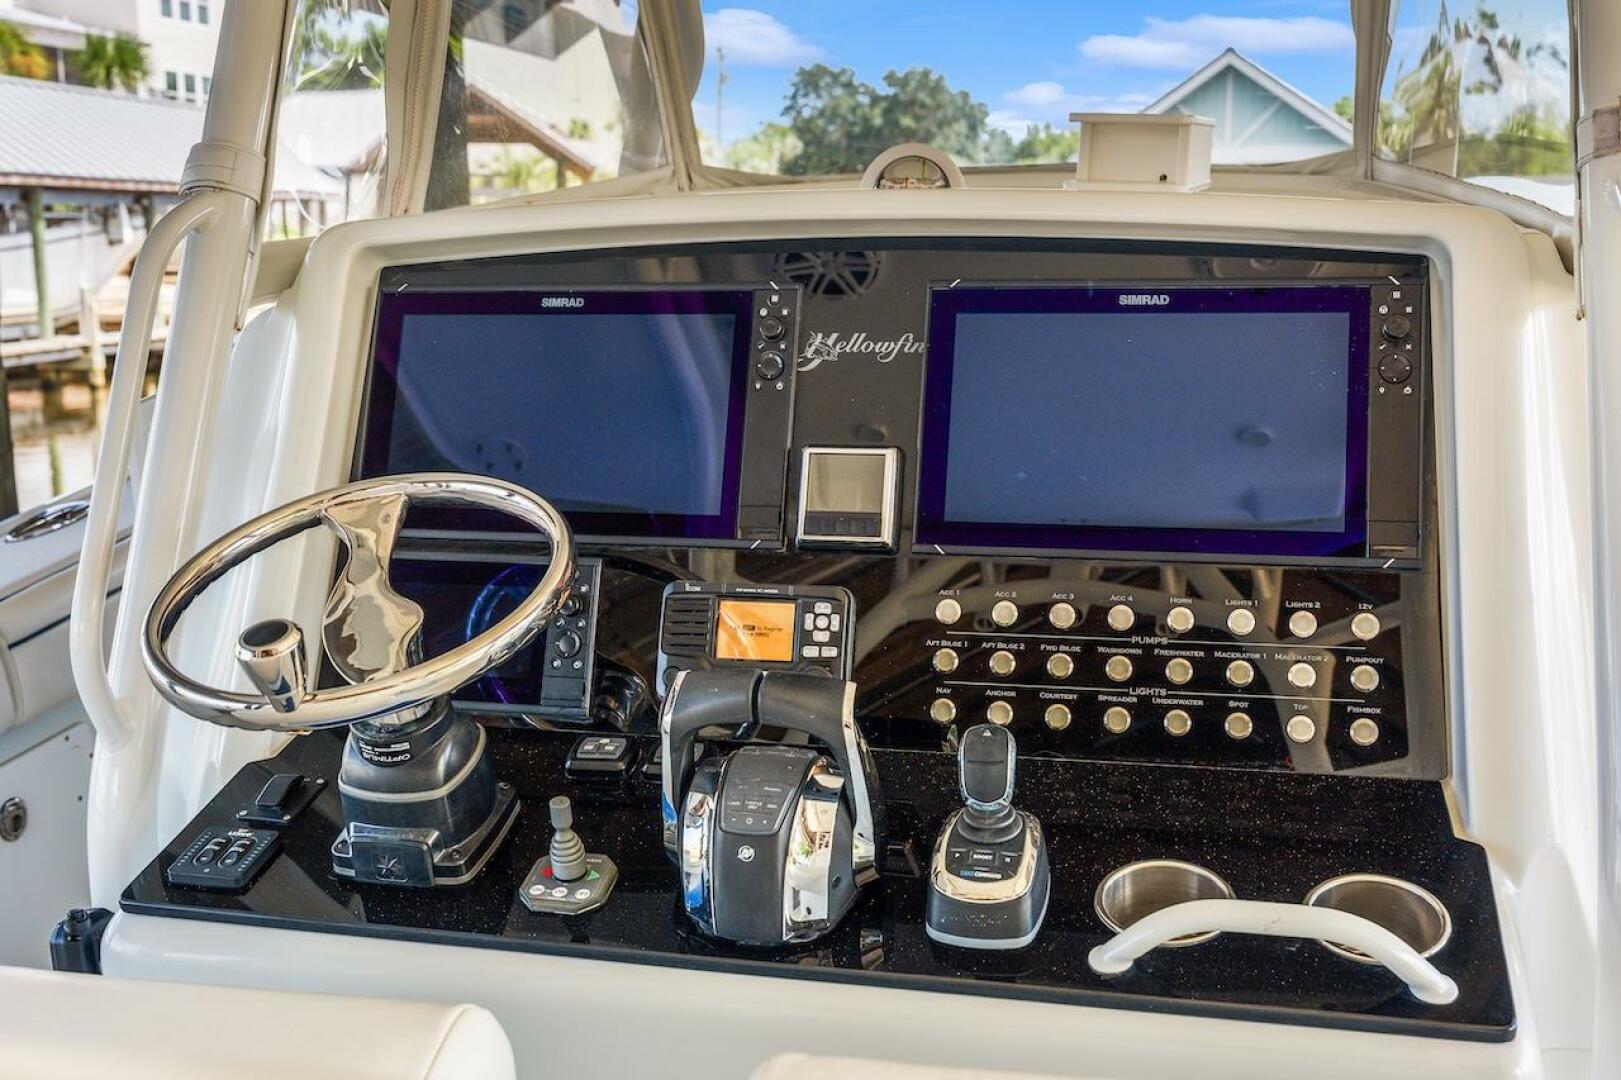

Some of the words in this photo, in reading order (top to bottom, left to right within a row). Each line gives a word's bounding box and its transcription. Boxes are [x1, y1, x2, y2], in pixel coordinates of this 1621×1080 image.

[541, 297, 585, 308] SIMRAD
[1118, 294, 1170, 306] SIMRAD
[1051, 592, 1068, 600] ACC
[1314, 601, 1321, 609] 2
[926, 639, 940, 647] AFT
[941, 640, 962, 648] BILGE
[1131, 636, 1169, 645] PUMPS
[981, 641, 996, 649] AFT
[997, 642, 1019, 650] BILGE
[1059, 645, 1082, 653] BILGE
[1097, 646, 1142, 655] WASHDOWN
[1154, 648, 1205, 657] FRESHWATER
[1214, 650, 1261, 659] MACERATOR
[1345, 656, 1384, 664] PUMPOUT
[985, 689, 1017, 697] ANCHOR
[1039, 691, 1079, 700] COURTESY
[1129, 687, 1167, 696] LIGHTS
[1097, 694, 1138, 703] SPREADER
[1152, 697, 1204, 706] UNDERWATER
[1346, 705, 1381, 714] FISHBOX
